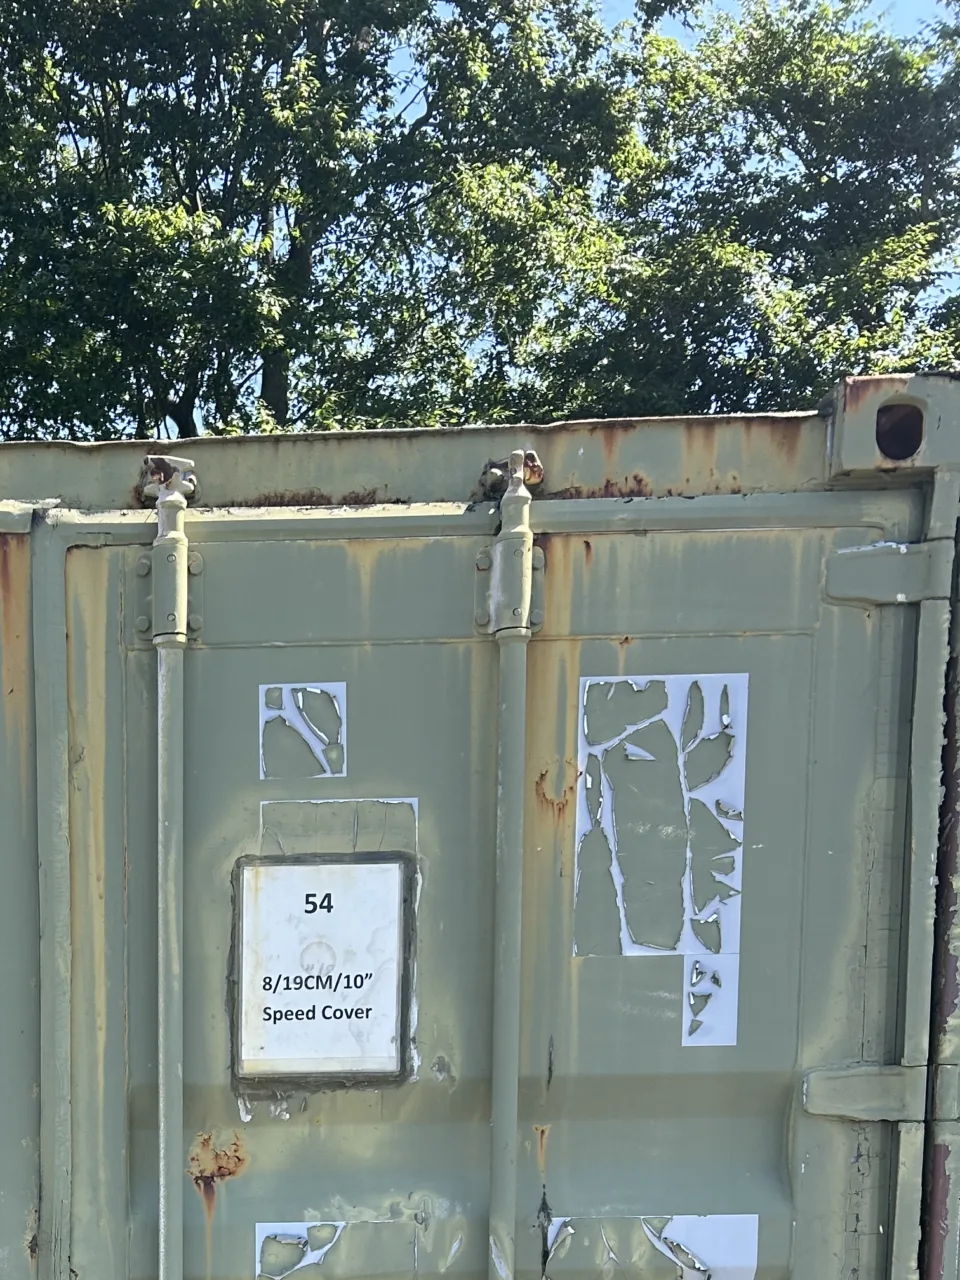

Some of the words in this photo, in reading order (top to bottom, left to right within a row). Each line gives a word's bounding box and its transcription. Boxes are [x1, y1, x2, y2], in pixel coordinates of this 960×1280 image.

[304, 893, 334, 914] 54
[262, 1005, 316, 1025] Speed
[321, 1005, 373, 1021] Cover
